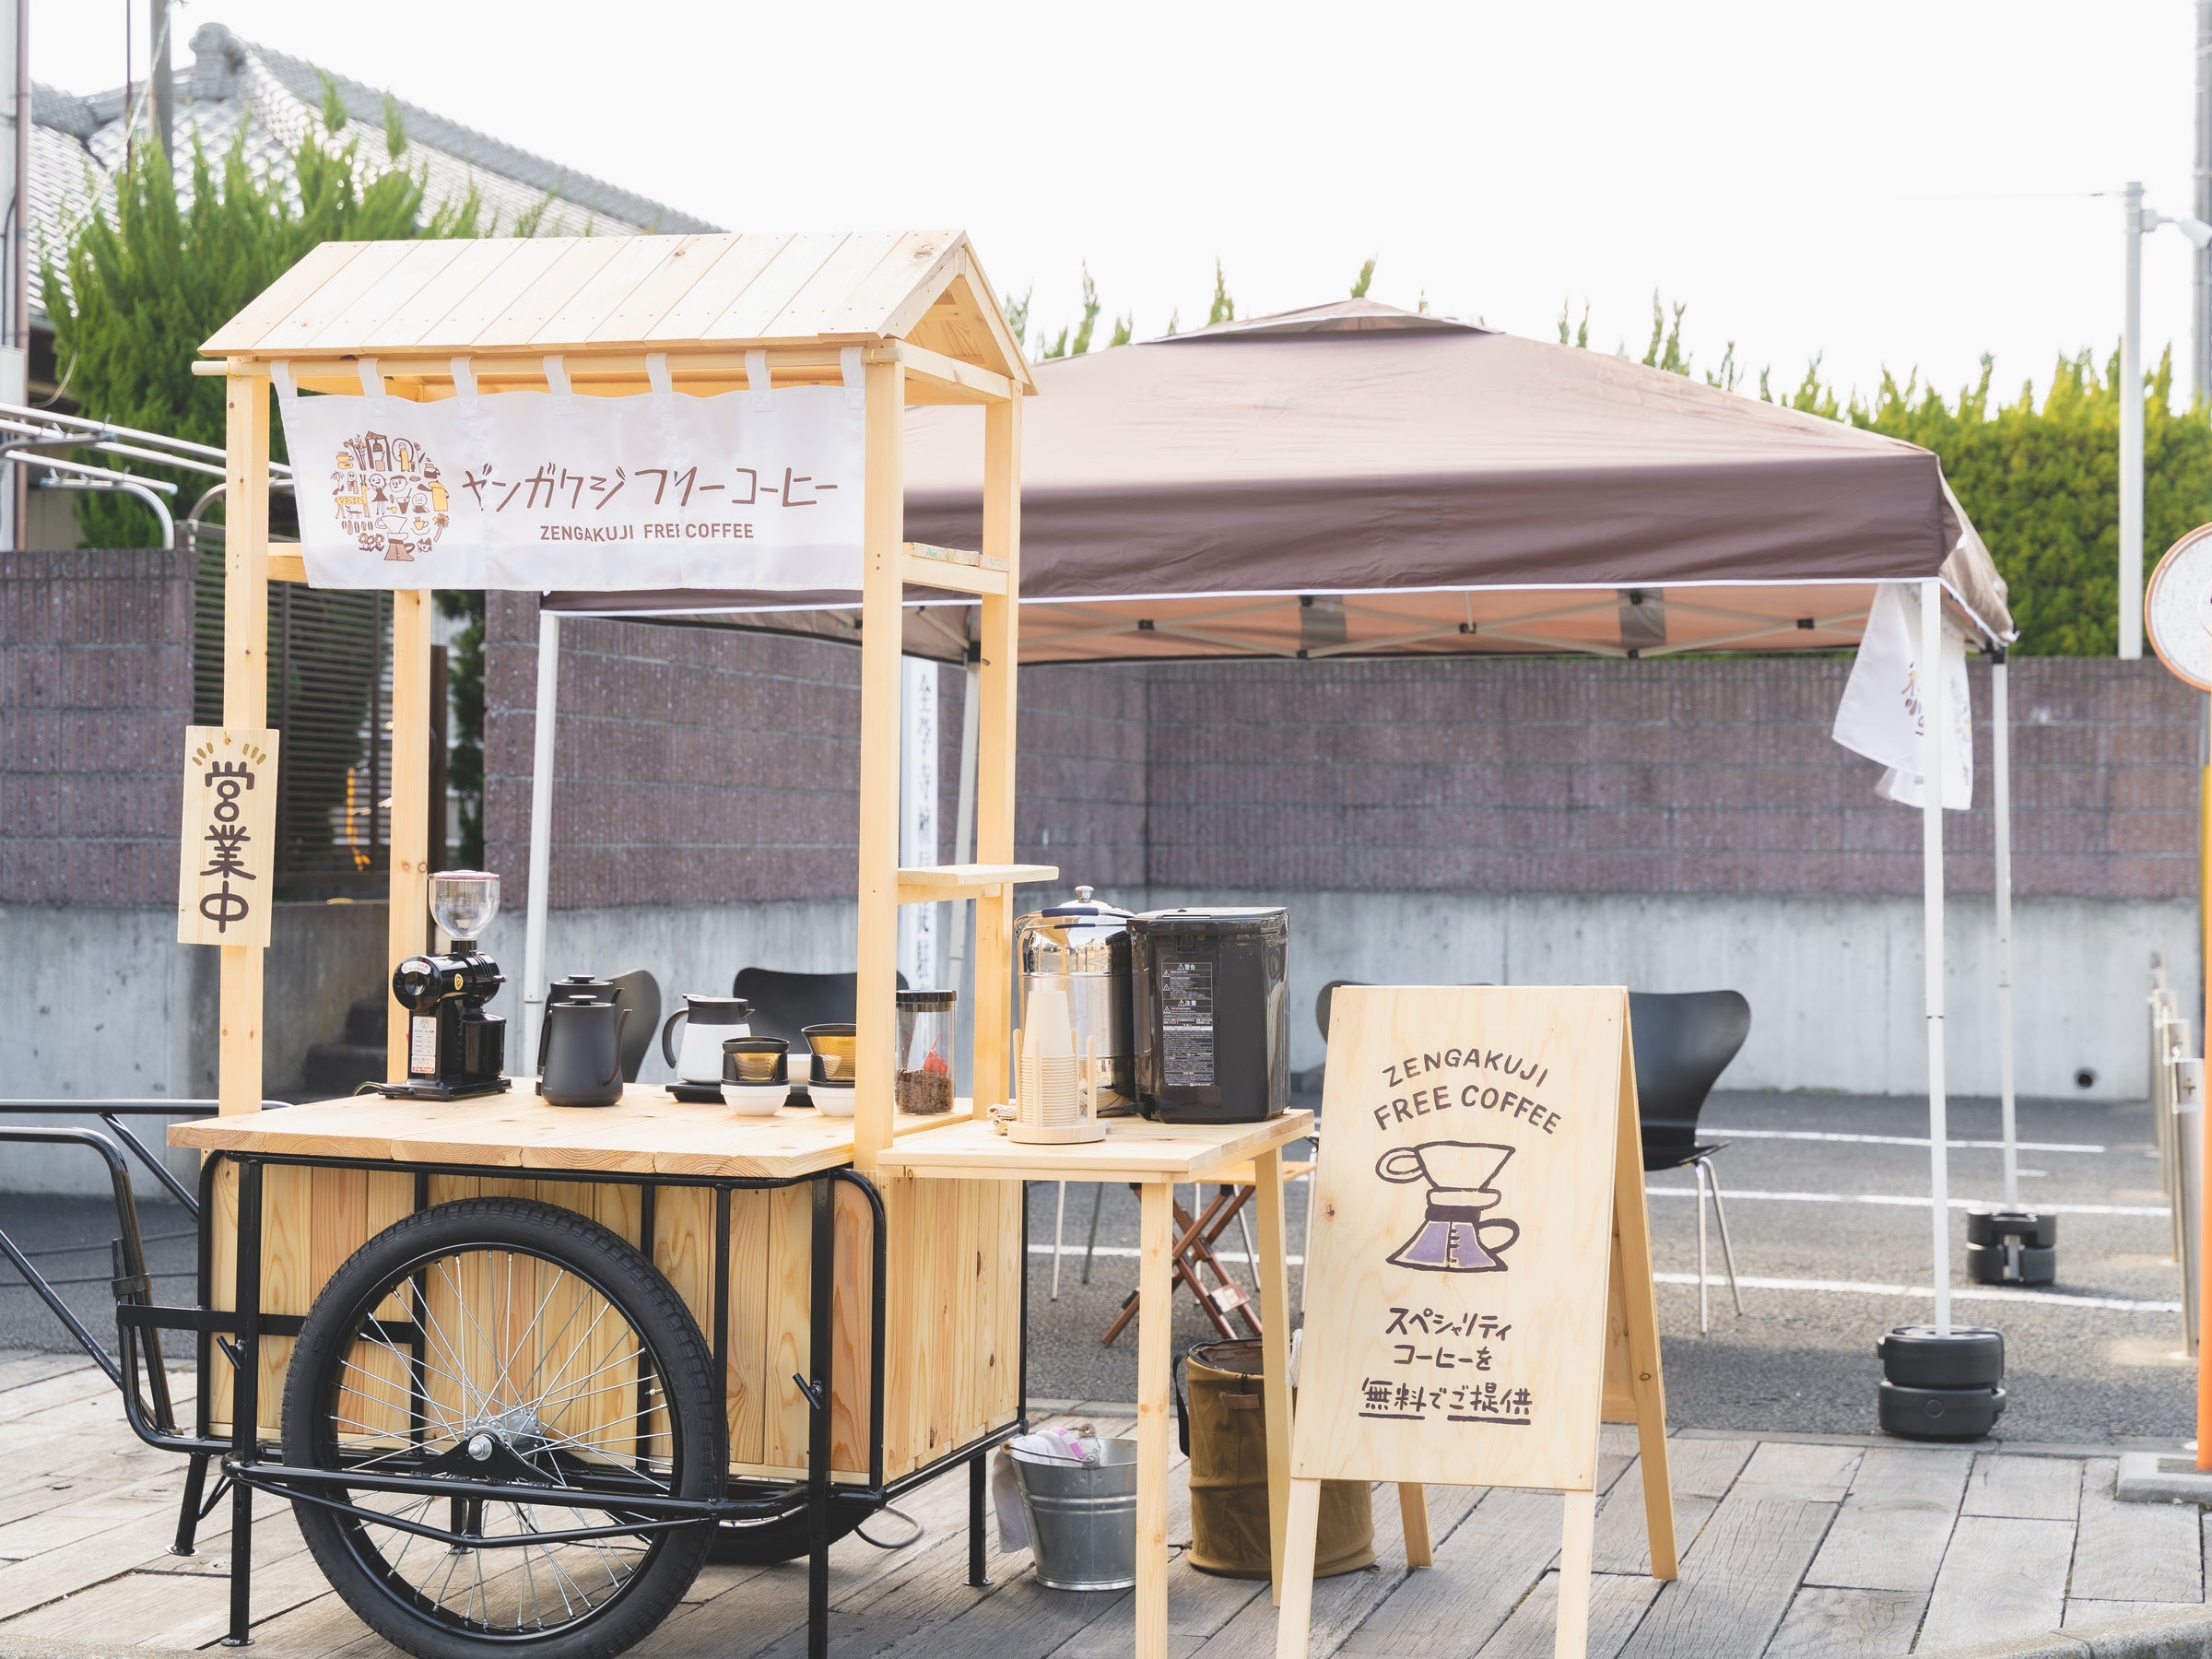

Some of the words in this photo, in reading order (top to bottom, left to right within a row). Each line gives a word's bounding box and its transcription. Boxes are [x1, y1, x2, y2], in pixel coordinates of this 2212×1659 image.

[539, 524, 634, 543] ZENGAKUJI
[685, 523, 754, 539] COFFEE
[199, 760, 258, 934] 営業中
[1382, 1048, 1548, 1088] ZENGAKUJI
[1373, 1085, 1452, 1131] FREE
[1461, 1085, 1561, 1135] COFFEE
[1385, 1307, 1512, 1341] スペシャリティ
[1394, 1344, 1492, 1371] コーヒーを
[1361, 1377, 1533, 1416] 無料でご提供
